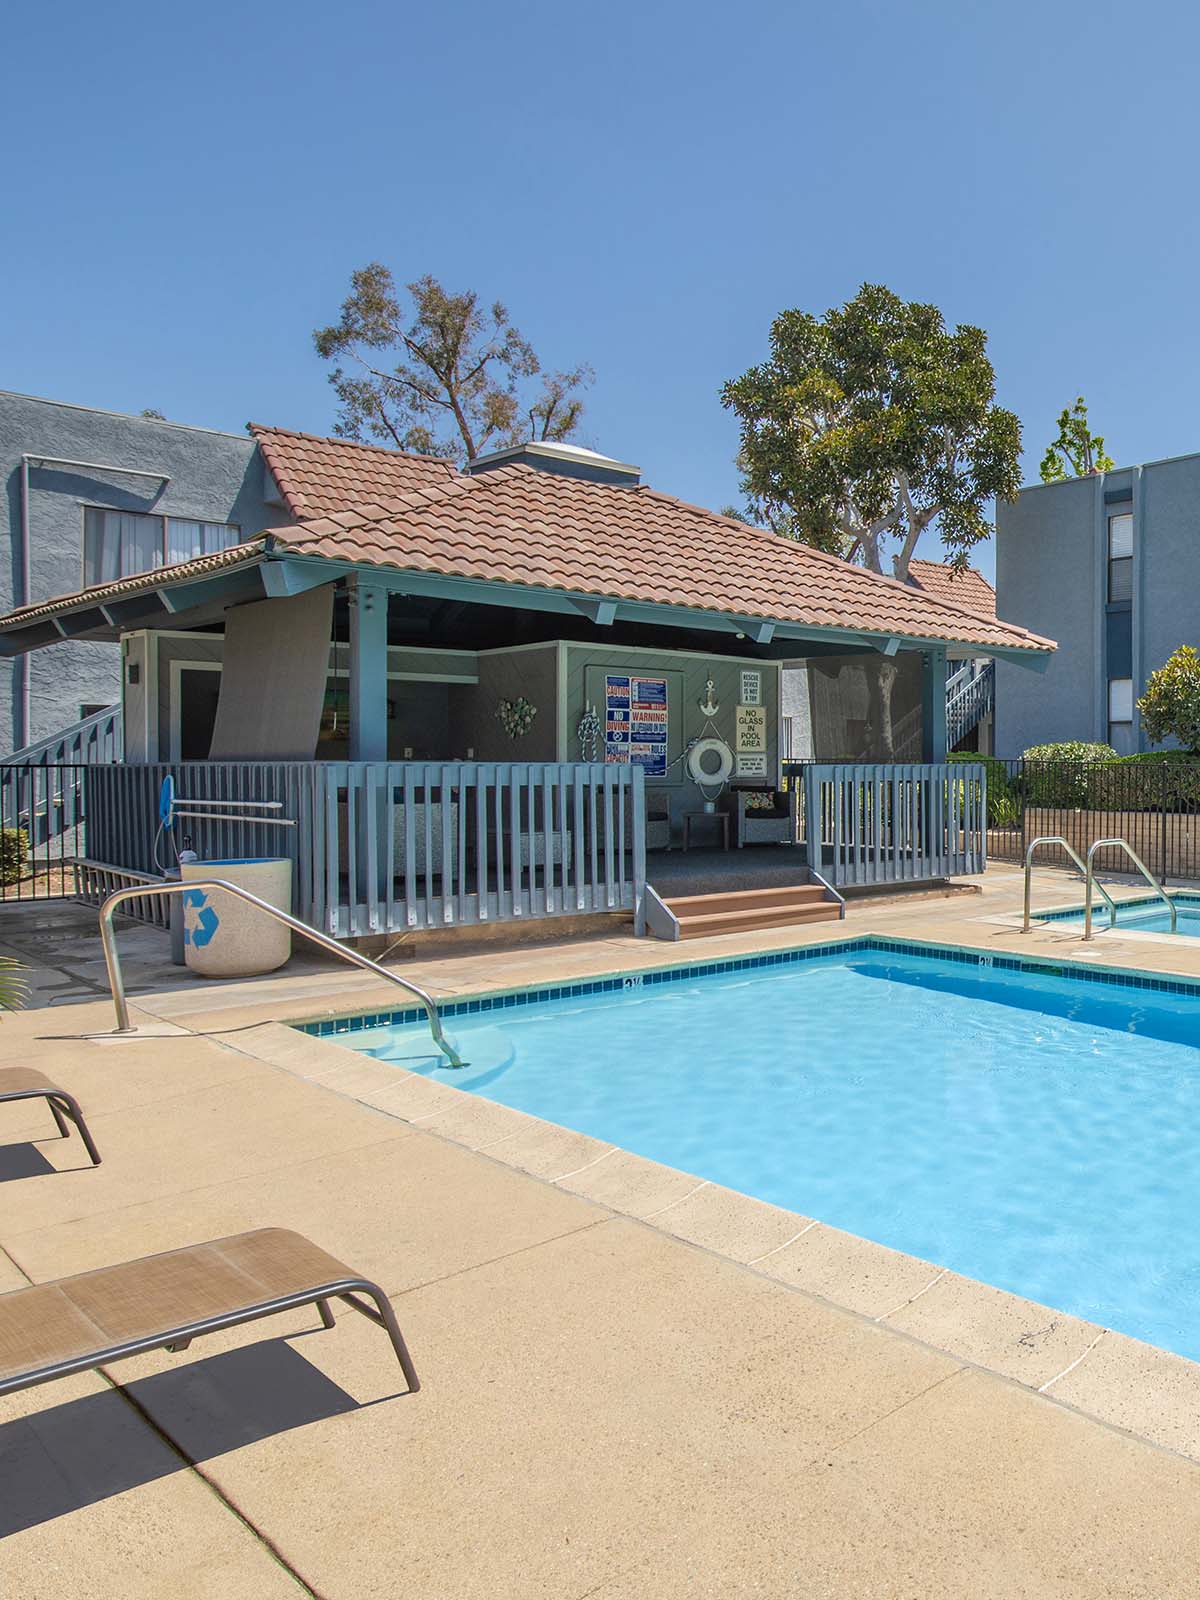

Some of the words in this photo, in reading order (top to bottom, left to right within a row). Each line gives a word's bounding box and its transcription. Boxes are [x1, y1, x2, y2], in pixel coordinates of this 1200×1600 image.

[607, 686, 630, 697] CAUTION
[613, 711, 624, 721] NO
[632, 711, 668, 723] WARNING!
[745, 709, 757, 717] NO
[738, 716, 764, 725] GLASS
[607, 721, 630, 732] DIVING
[740, 732, 761, 740] POOL
